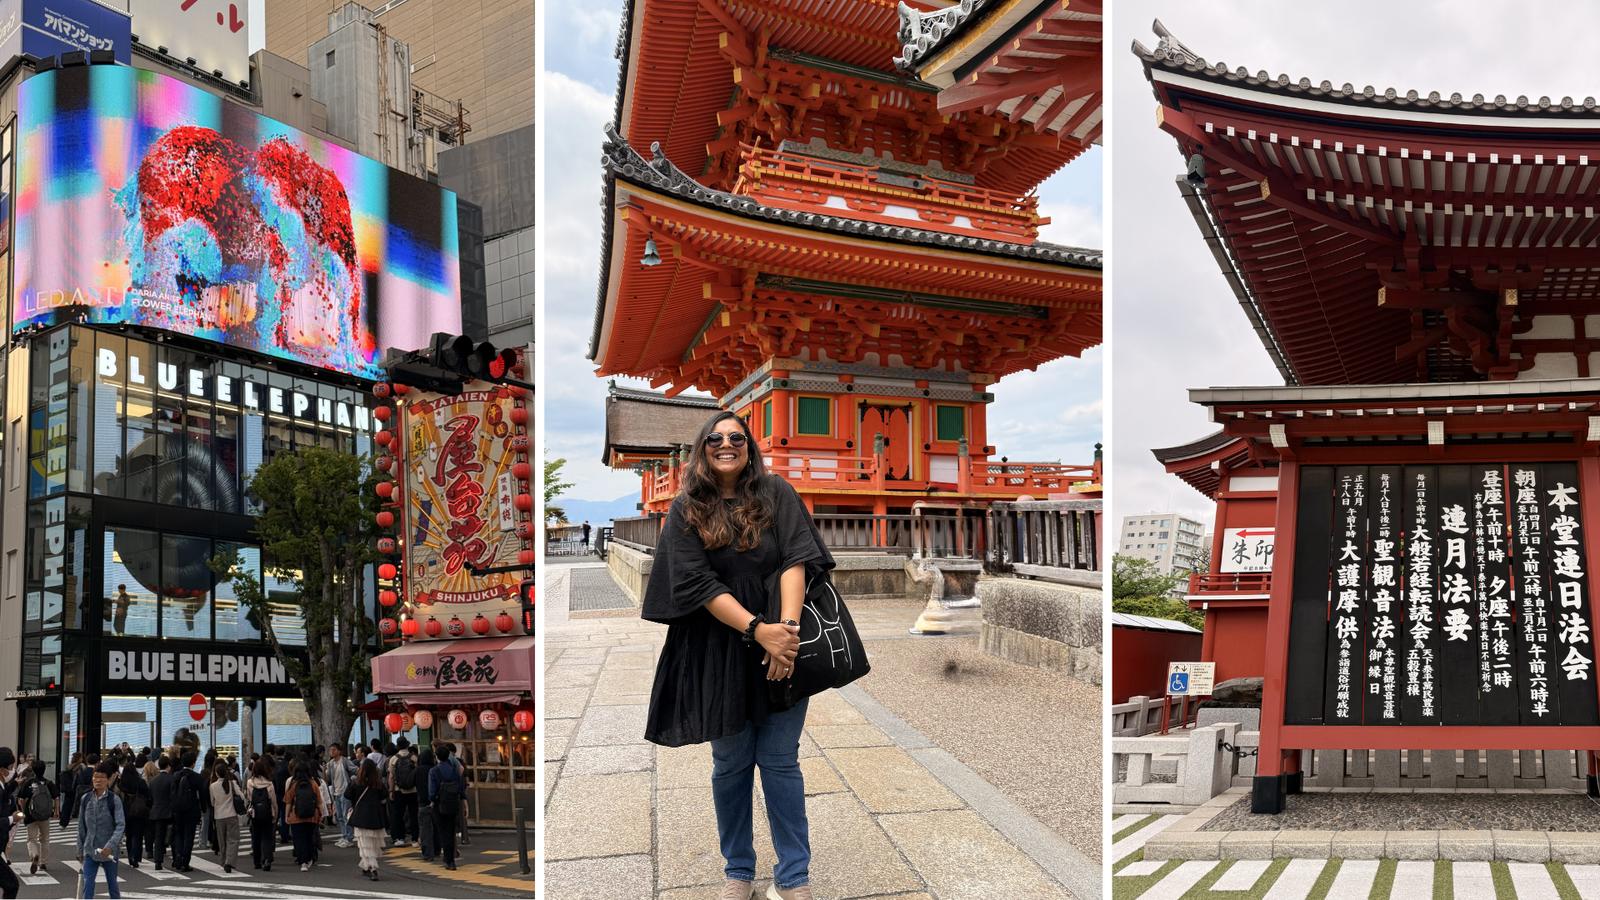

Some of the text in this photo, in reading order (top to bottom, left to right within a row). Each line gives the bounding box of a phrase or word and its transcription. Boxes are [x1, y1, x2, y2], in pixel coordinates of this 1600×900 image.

[44, 13, 114, 51] アパマンショップ
[131, 288, 158, 298] DARIA
[131, 298, 215, 322] FLOWER ELEPHANT
[430, 392, 489, 410] YATAIEN
[1441, 503, 1473, 641] 連月法要
[1546, 482, 1592, 681] 本堂連日法会
[436, 588, 499, 603] SHINJUKU
[109, 651, 175, 681] BLUE
[434, 654, 499, 689] 屋台苑
